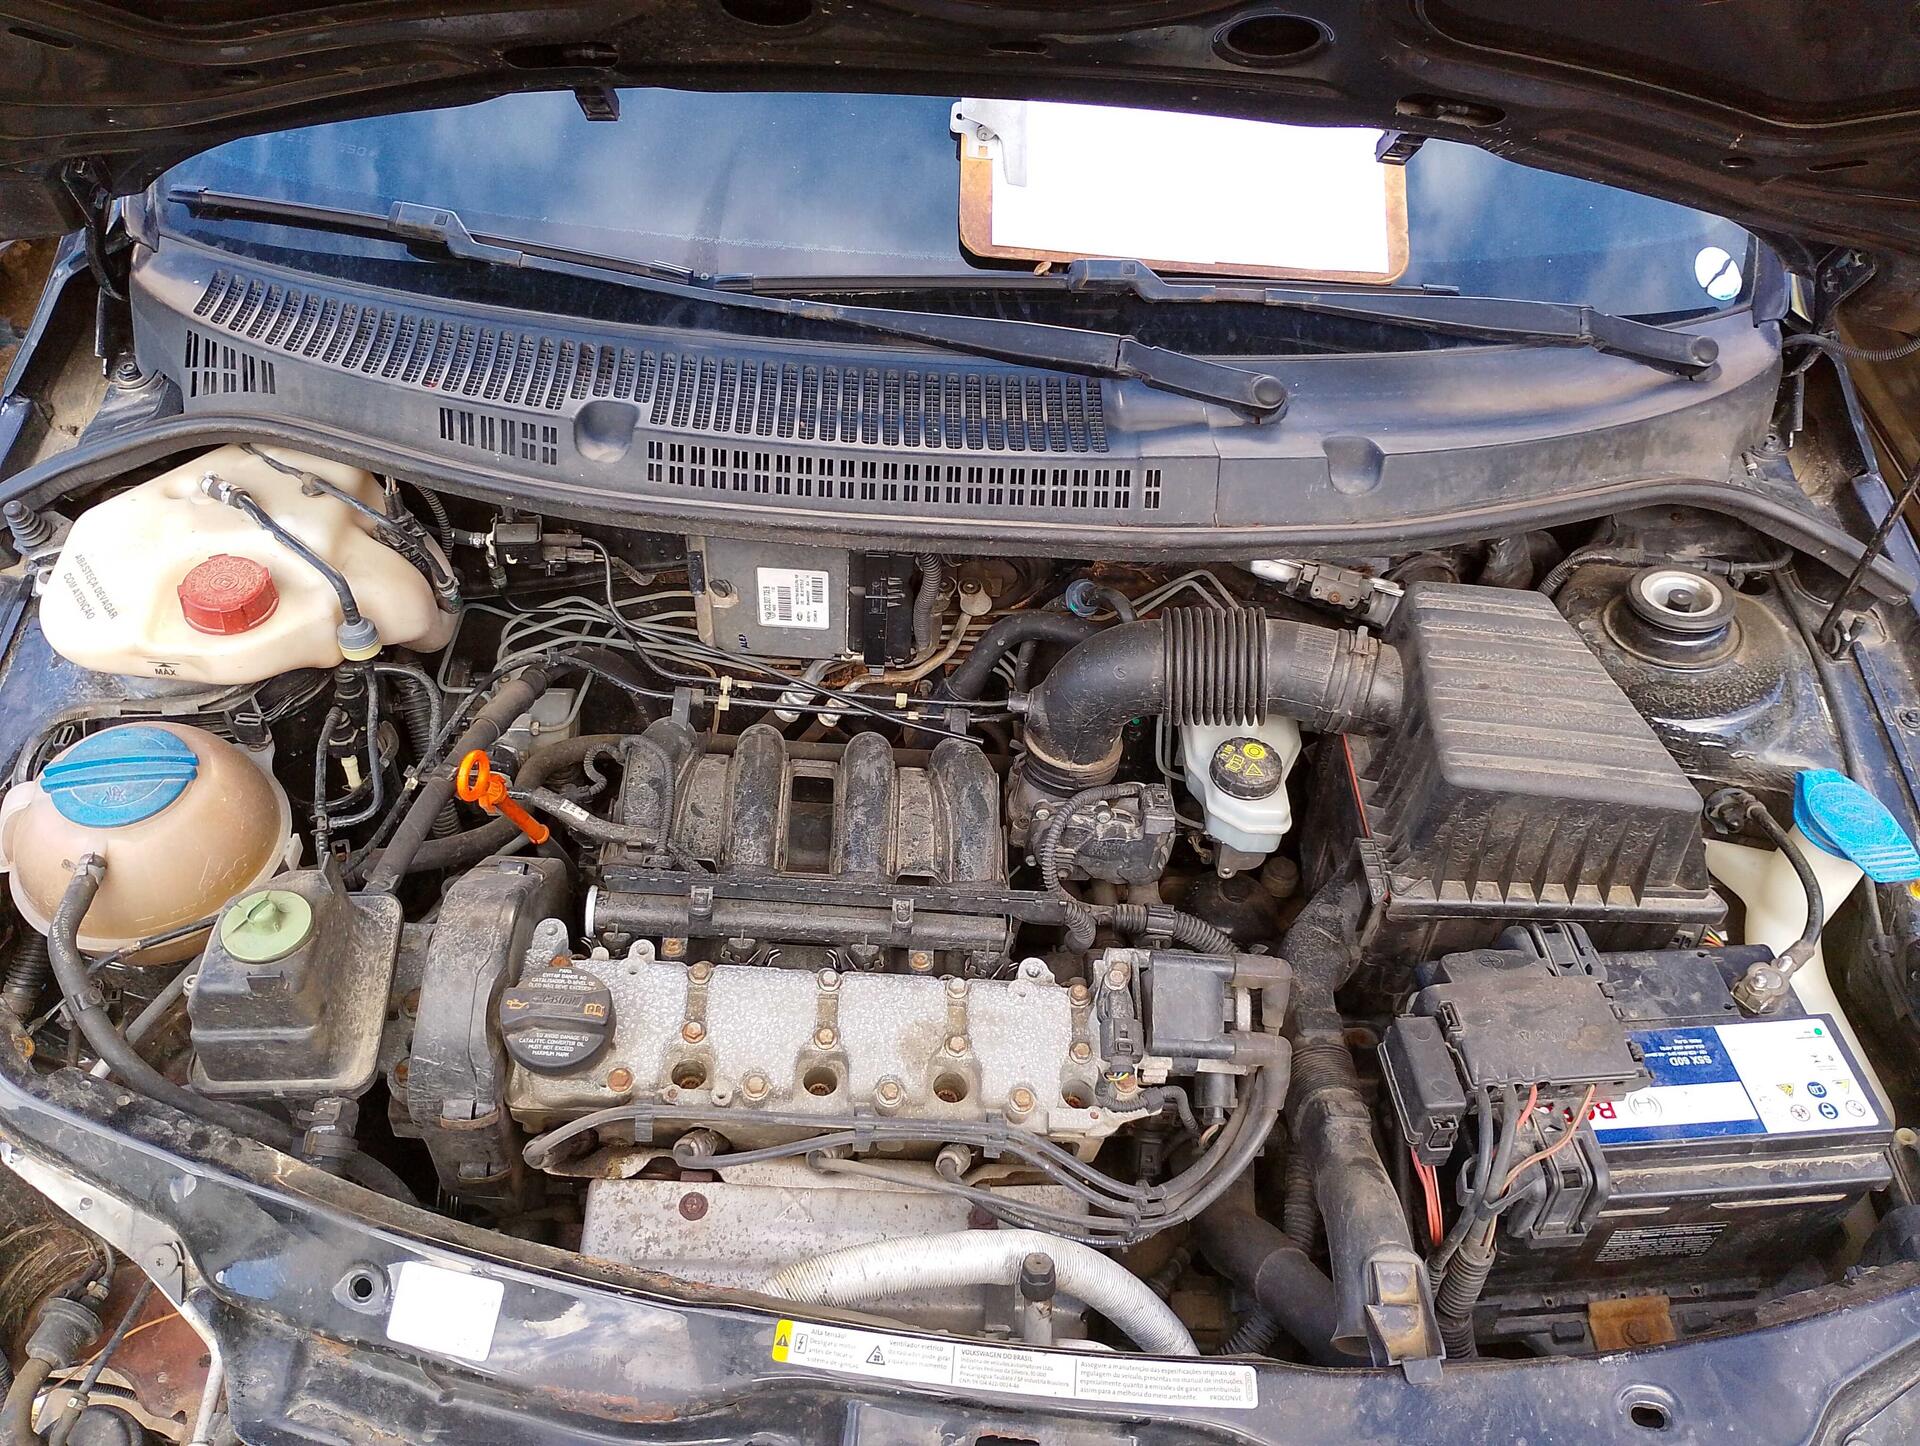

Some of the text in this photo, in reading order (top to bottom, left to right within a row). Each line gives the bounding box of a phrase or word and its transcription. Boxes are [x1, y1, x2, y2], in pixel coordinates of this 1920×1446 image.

[75, 554, 118, 620] ABASTEÇA DEVAGAR
[64, 572, 96, 620] COM ATENÇÃO
[1669, 1056, 1690, 1066] 60D
[890, 1340, 920, 1349] Ventilador
[961, 1349, 1001, 1359] VOLKSWAGEN
